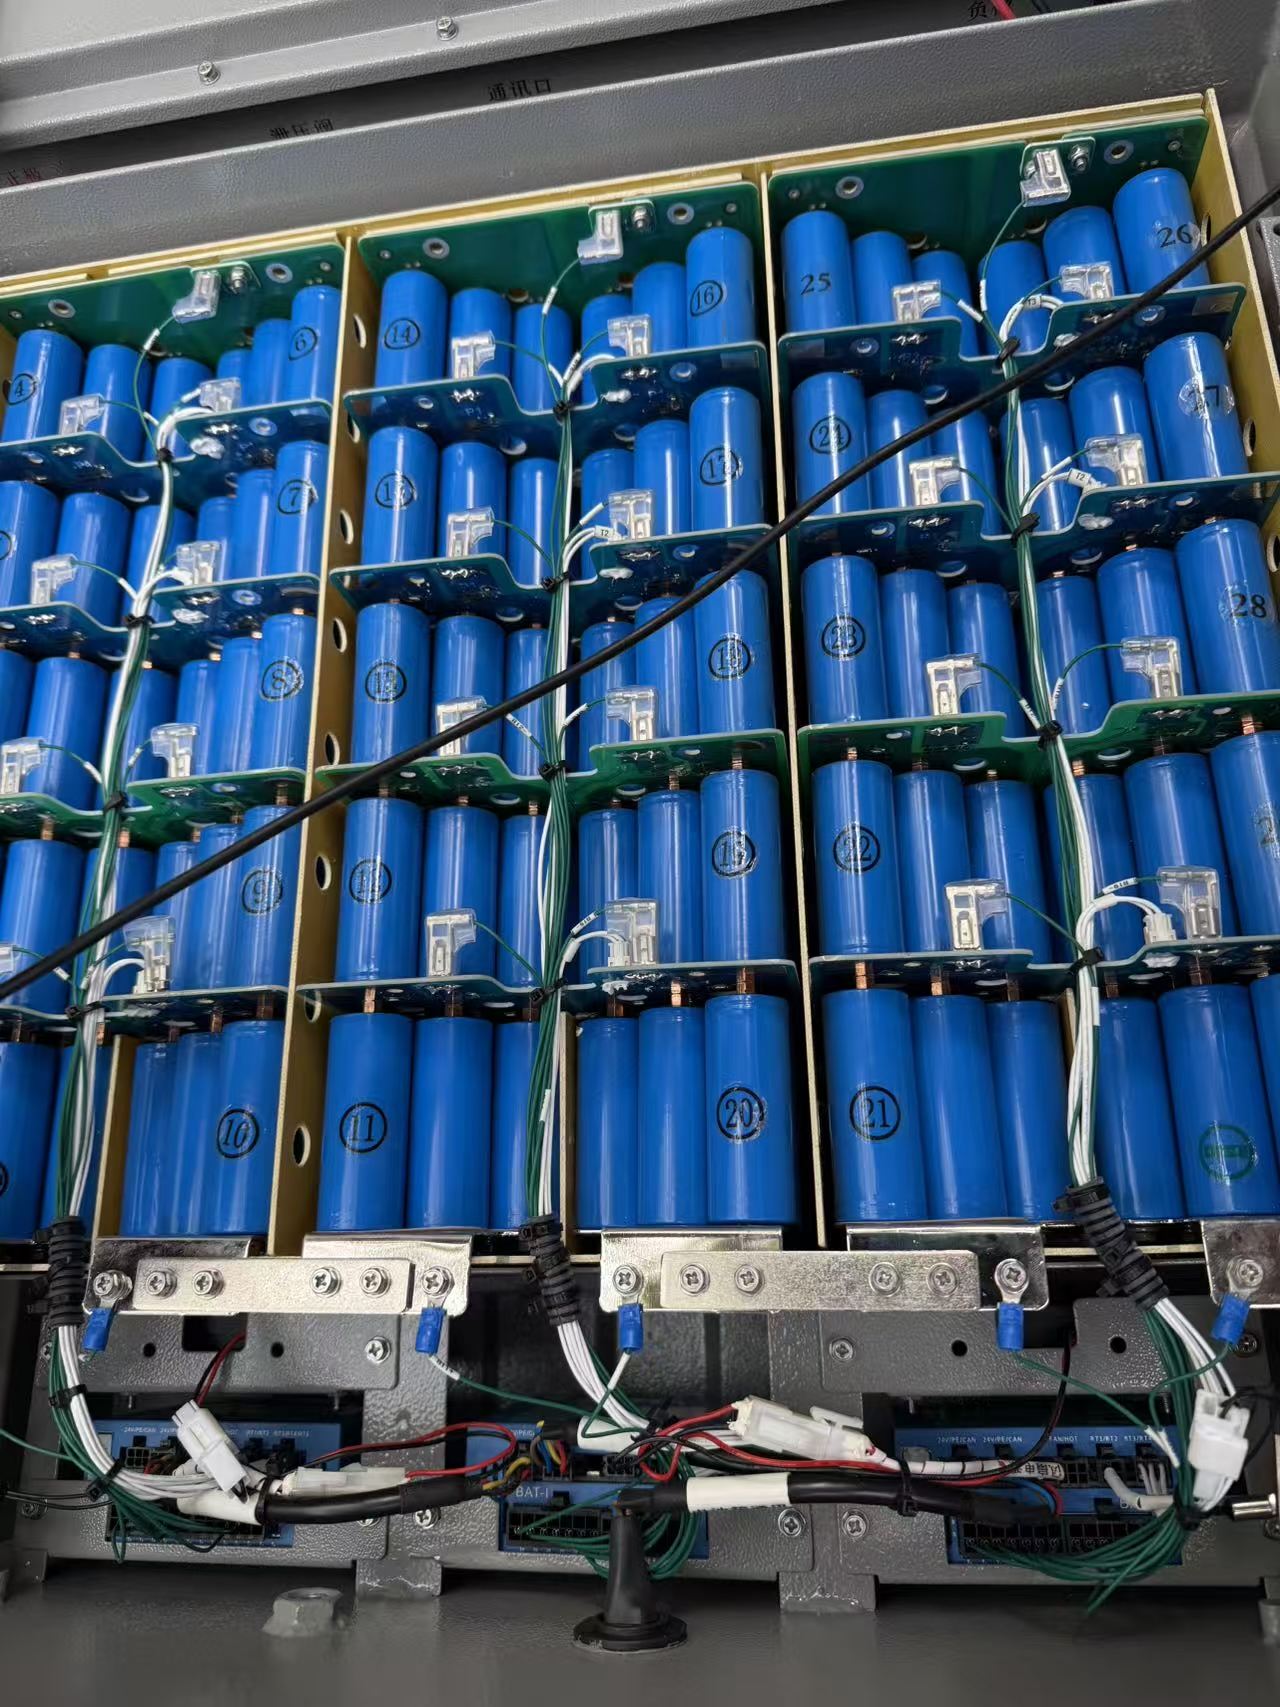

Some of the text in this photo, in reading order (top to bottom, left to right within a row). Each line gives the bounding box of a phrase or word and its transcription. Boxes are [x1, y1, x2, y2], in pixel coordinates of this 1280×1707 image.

[488, 78, 552, 101] 通讯口
[1157, 223, 1193, 248] 26
[800, 273, 832, 296] 25
[695, 286, 715, 312] 16
[390, 326, 412, 344] 14
[818, 424, 845, 448] 24
[1074, 472, 1086, 481] T2
[600, 529, 610, 537] T2
[1230, 593, 1267, 619] 28
[724, 1097, 755, 1129] 20
[863, 1098, 890, 1129] 21
[222, 1118, 250, 1149] 10
[350, 1114, 375, 1143] 11
